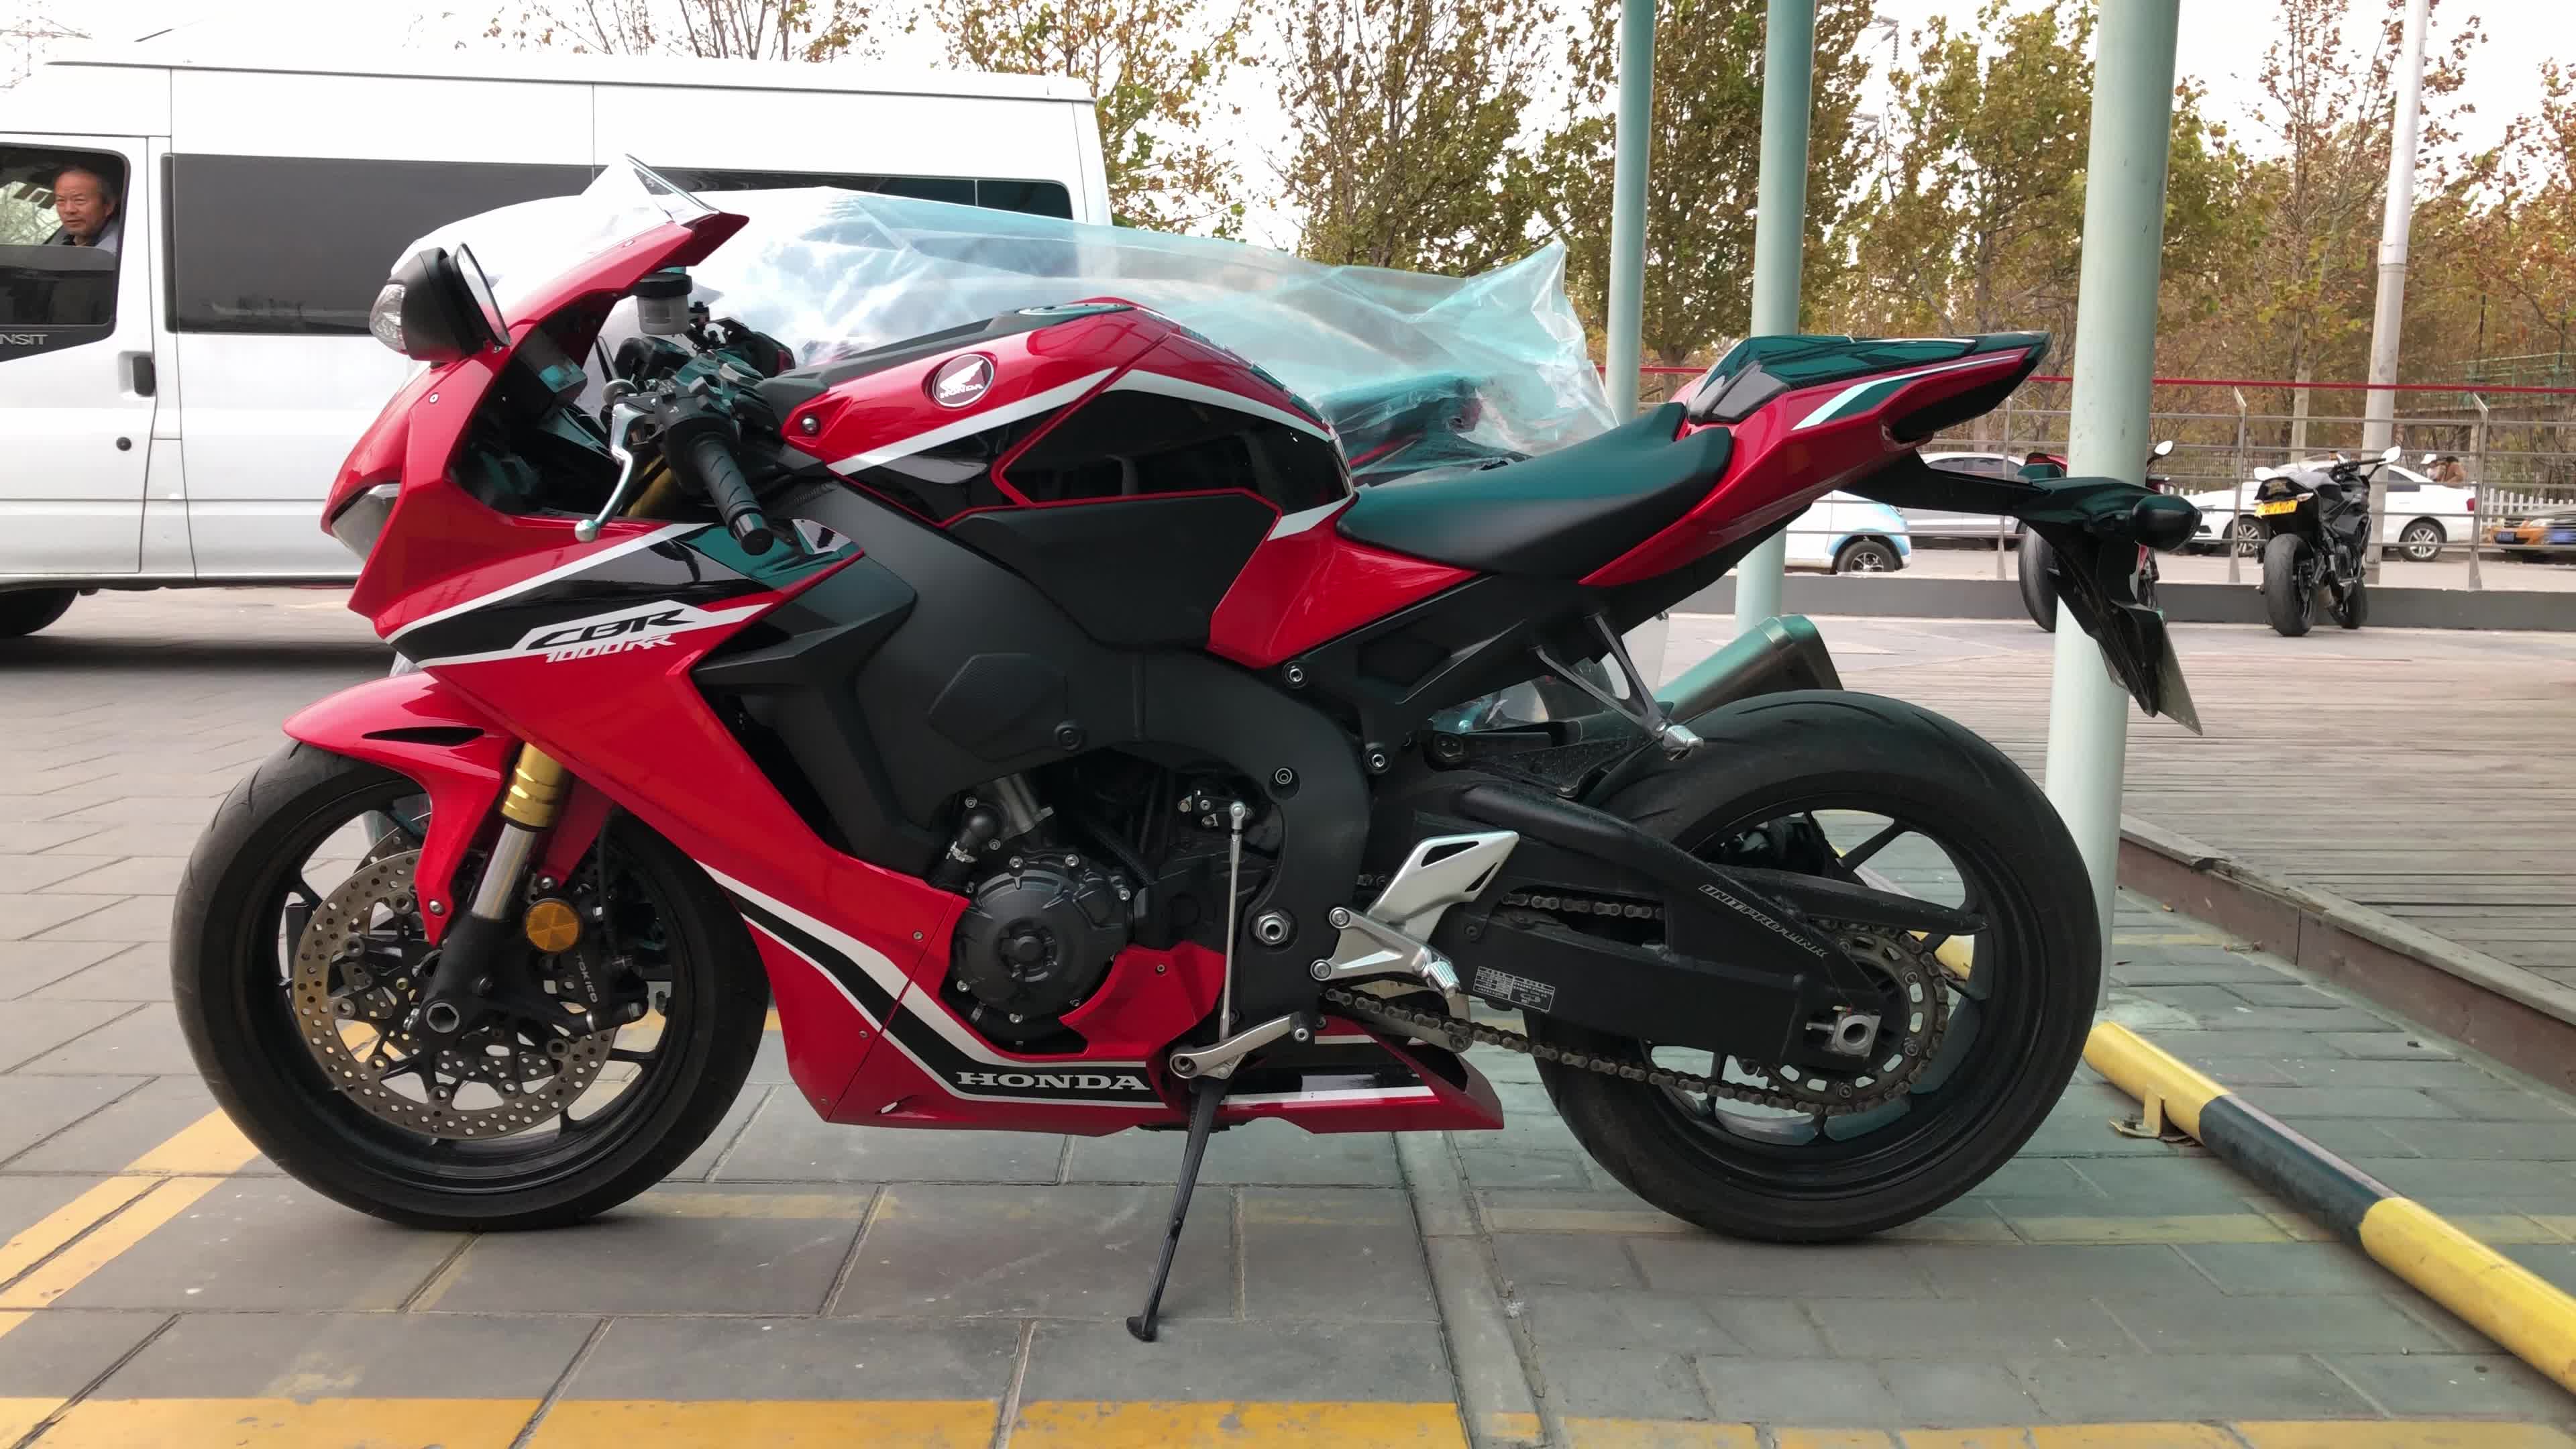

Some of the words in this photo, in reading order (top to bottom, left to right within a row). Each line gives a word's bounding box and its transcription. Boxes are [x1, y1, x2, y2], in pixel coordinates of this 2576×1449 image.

[940, 384, 983, 398] HONDA
[526, 608, 696, 651] CBR
[546, 634, 677, 663] 1000RR
[576, 955, 598, 1003] TOKICO
[957, 1072, 1150, 1090] HONDA
